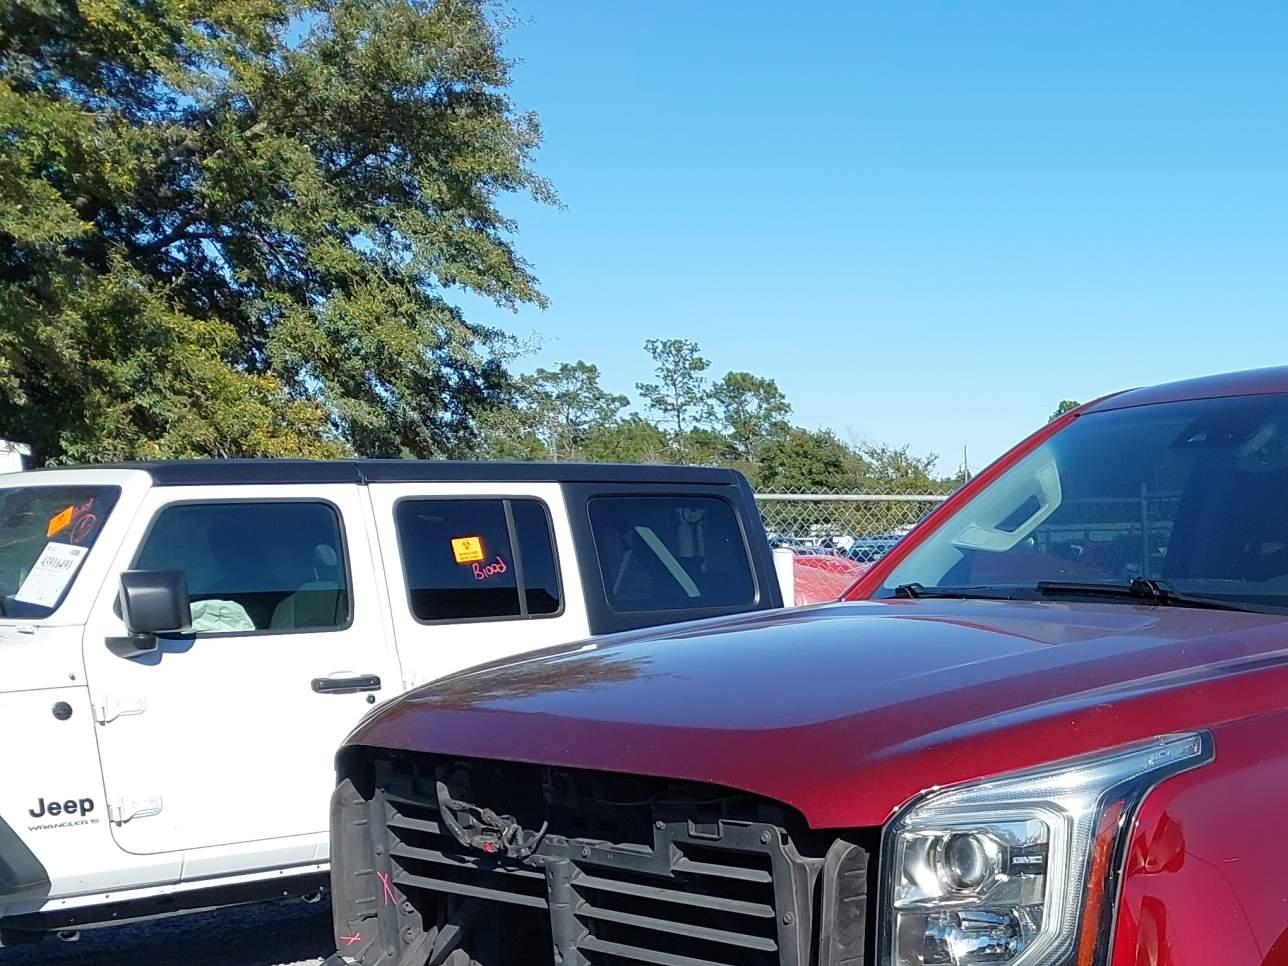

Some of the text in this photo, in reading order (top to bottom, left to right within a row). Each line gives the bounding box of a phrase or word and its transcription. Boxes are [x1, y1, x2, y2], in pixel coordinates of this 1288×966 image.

[472, 556, 507, 580] Blood
[28, 797, 95, 818] Jeep
[1012, 855, 1043, 865] GMC
